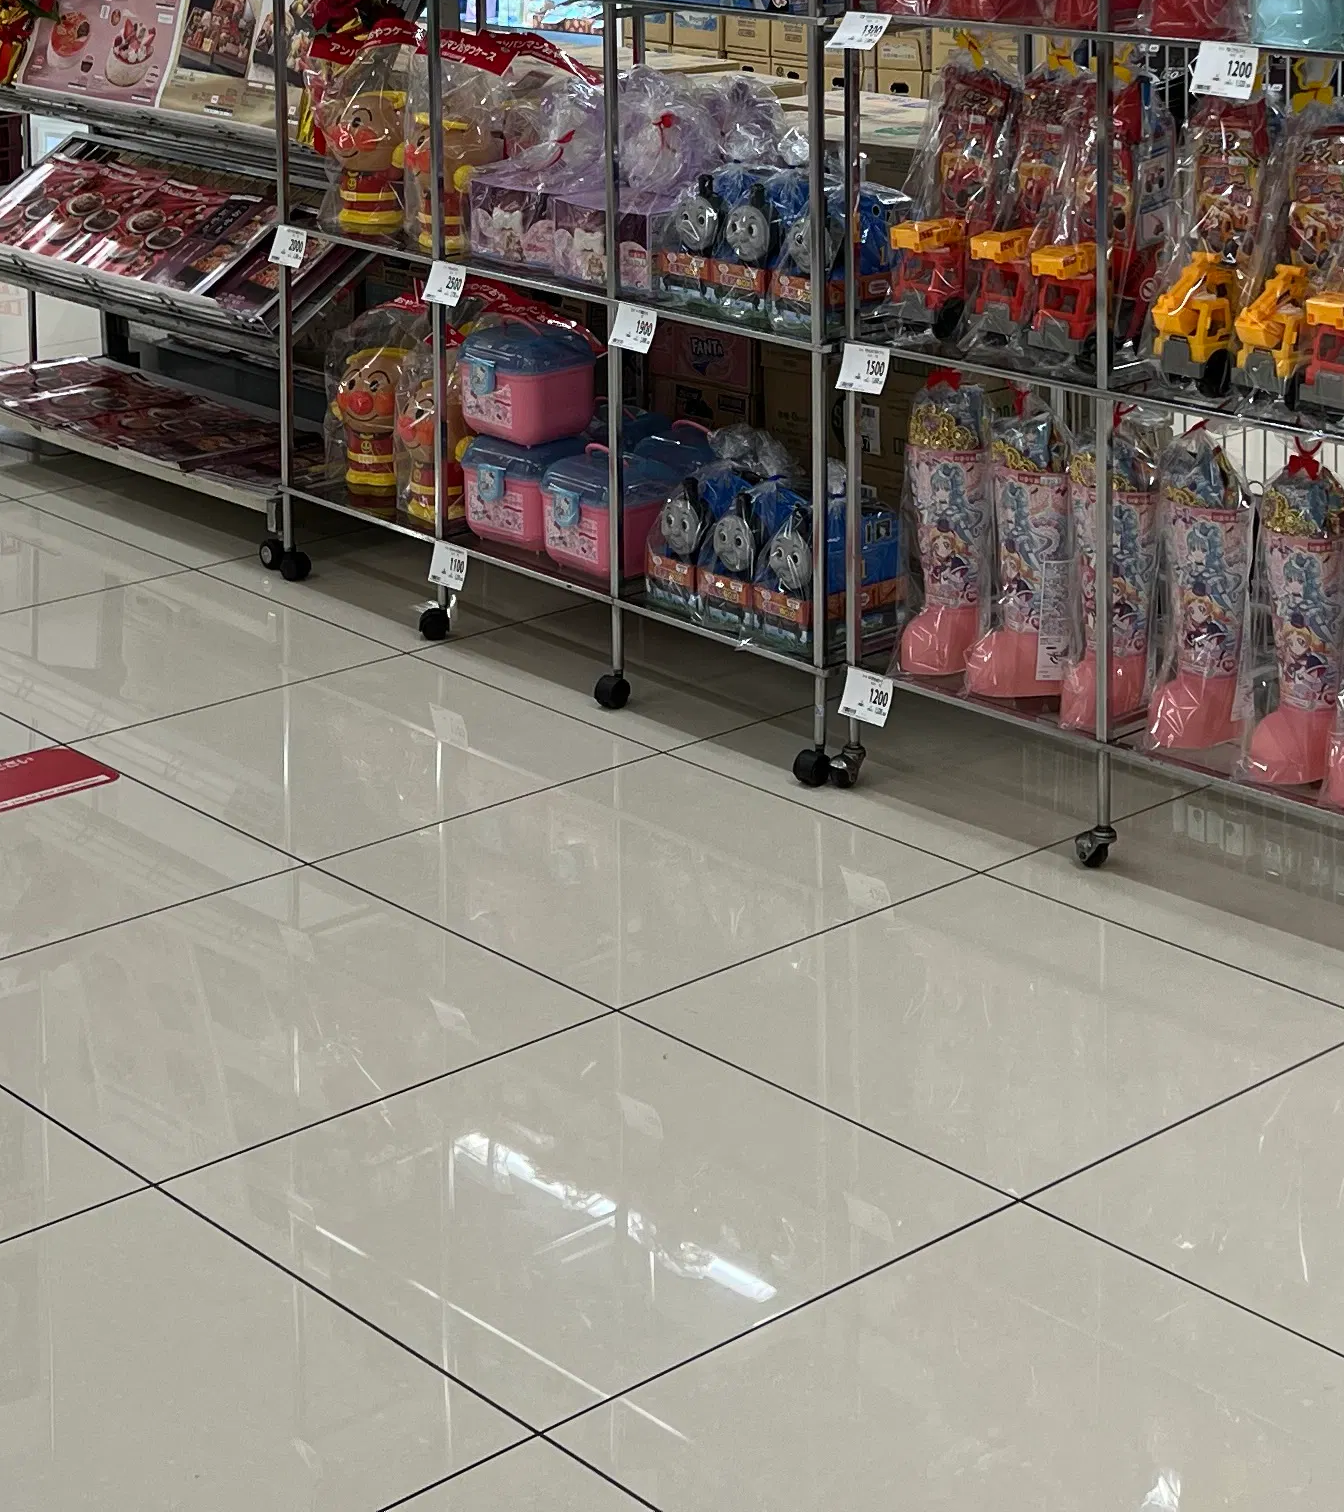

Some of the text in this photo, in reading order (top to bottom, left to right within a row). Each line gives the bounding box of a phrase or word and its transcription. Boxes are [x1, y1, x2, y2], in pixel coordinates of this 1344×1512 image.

[1226, 60, 1254, 79] 1200
[866, 360, 885, 377] 1500
[449, 556, 465, 573] 1100
[869, 688, 889, 707] 1200
